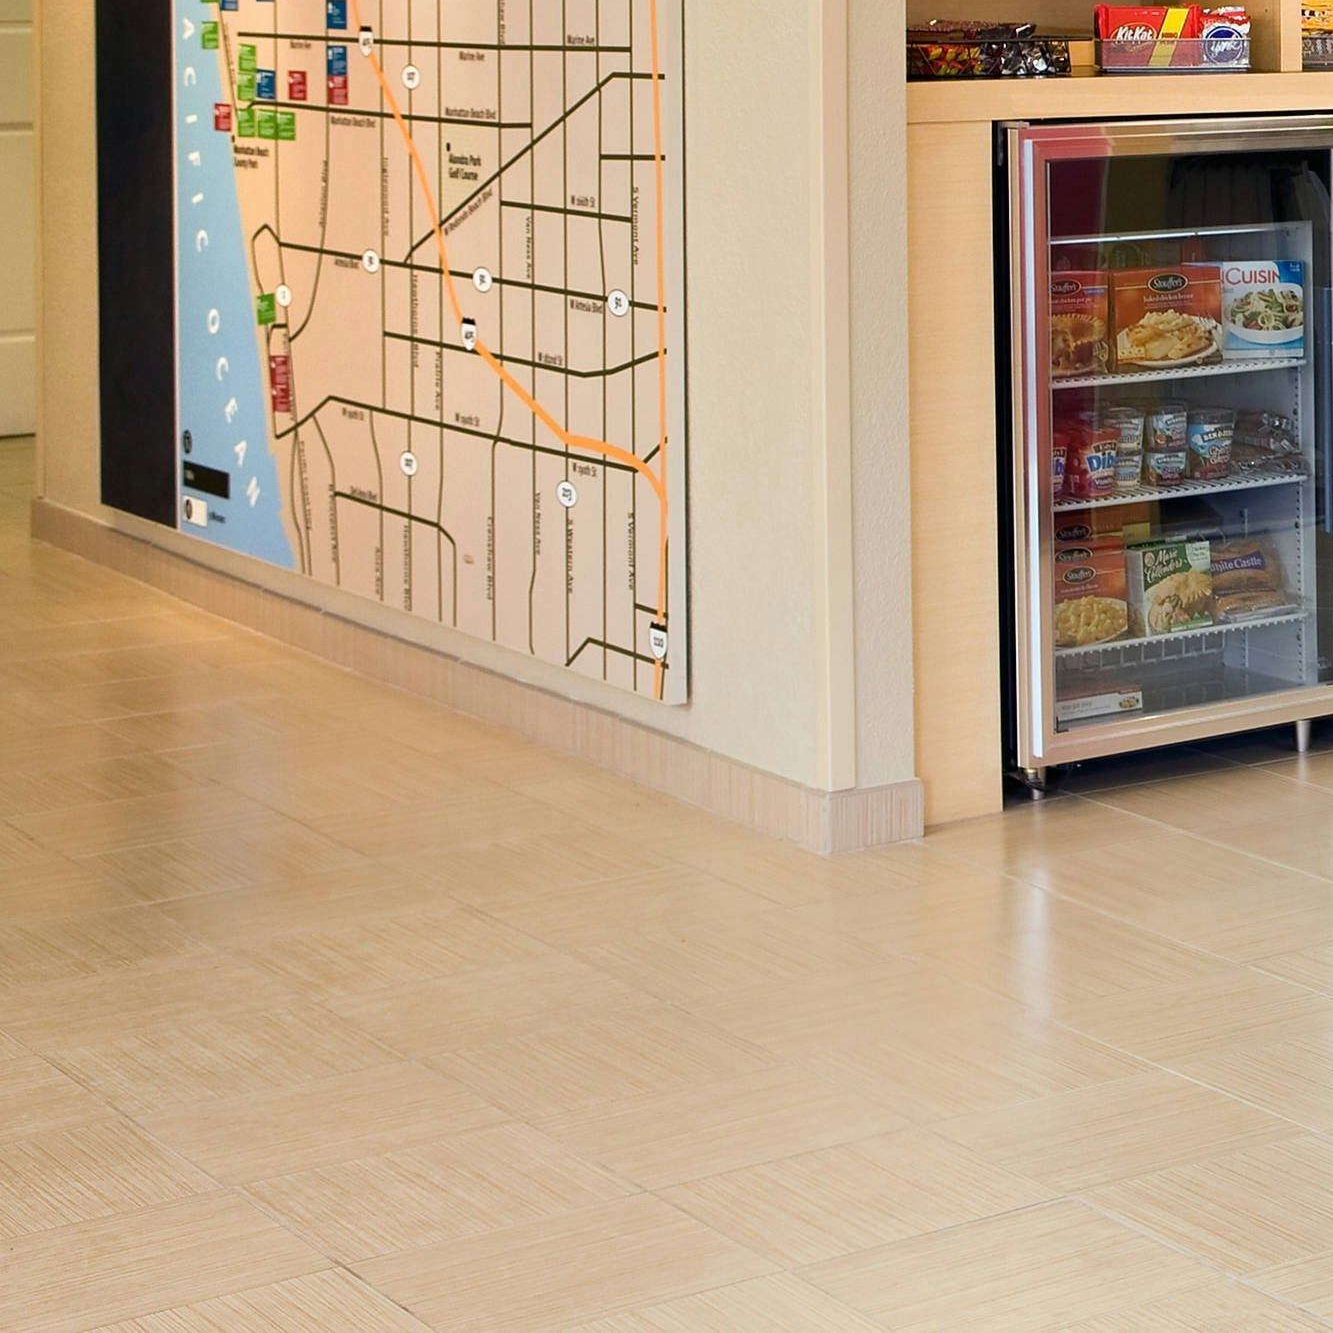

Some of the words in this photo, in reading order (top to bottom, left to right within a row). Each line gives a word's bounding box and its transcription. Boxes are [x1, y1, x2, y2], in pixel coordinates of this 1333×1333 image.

[1225, 267, 1280, 285] CUISIN
[207, 308, 260, 507] OCEAN
[1087, 452, 1115, 471] Dib
[1233, 556, 1262, 568] Castle
